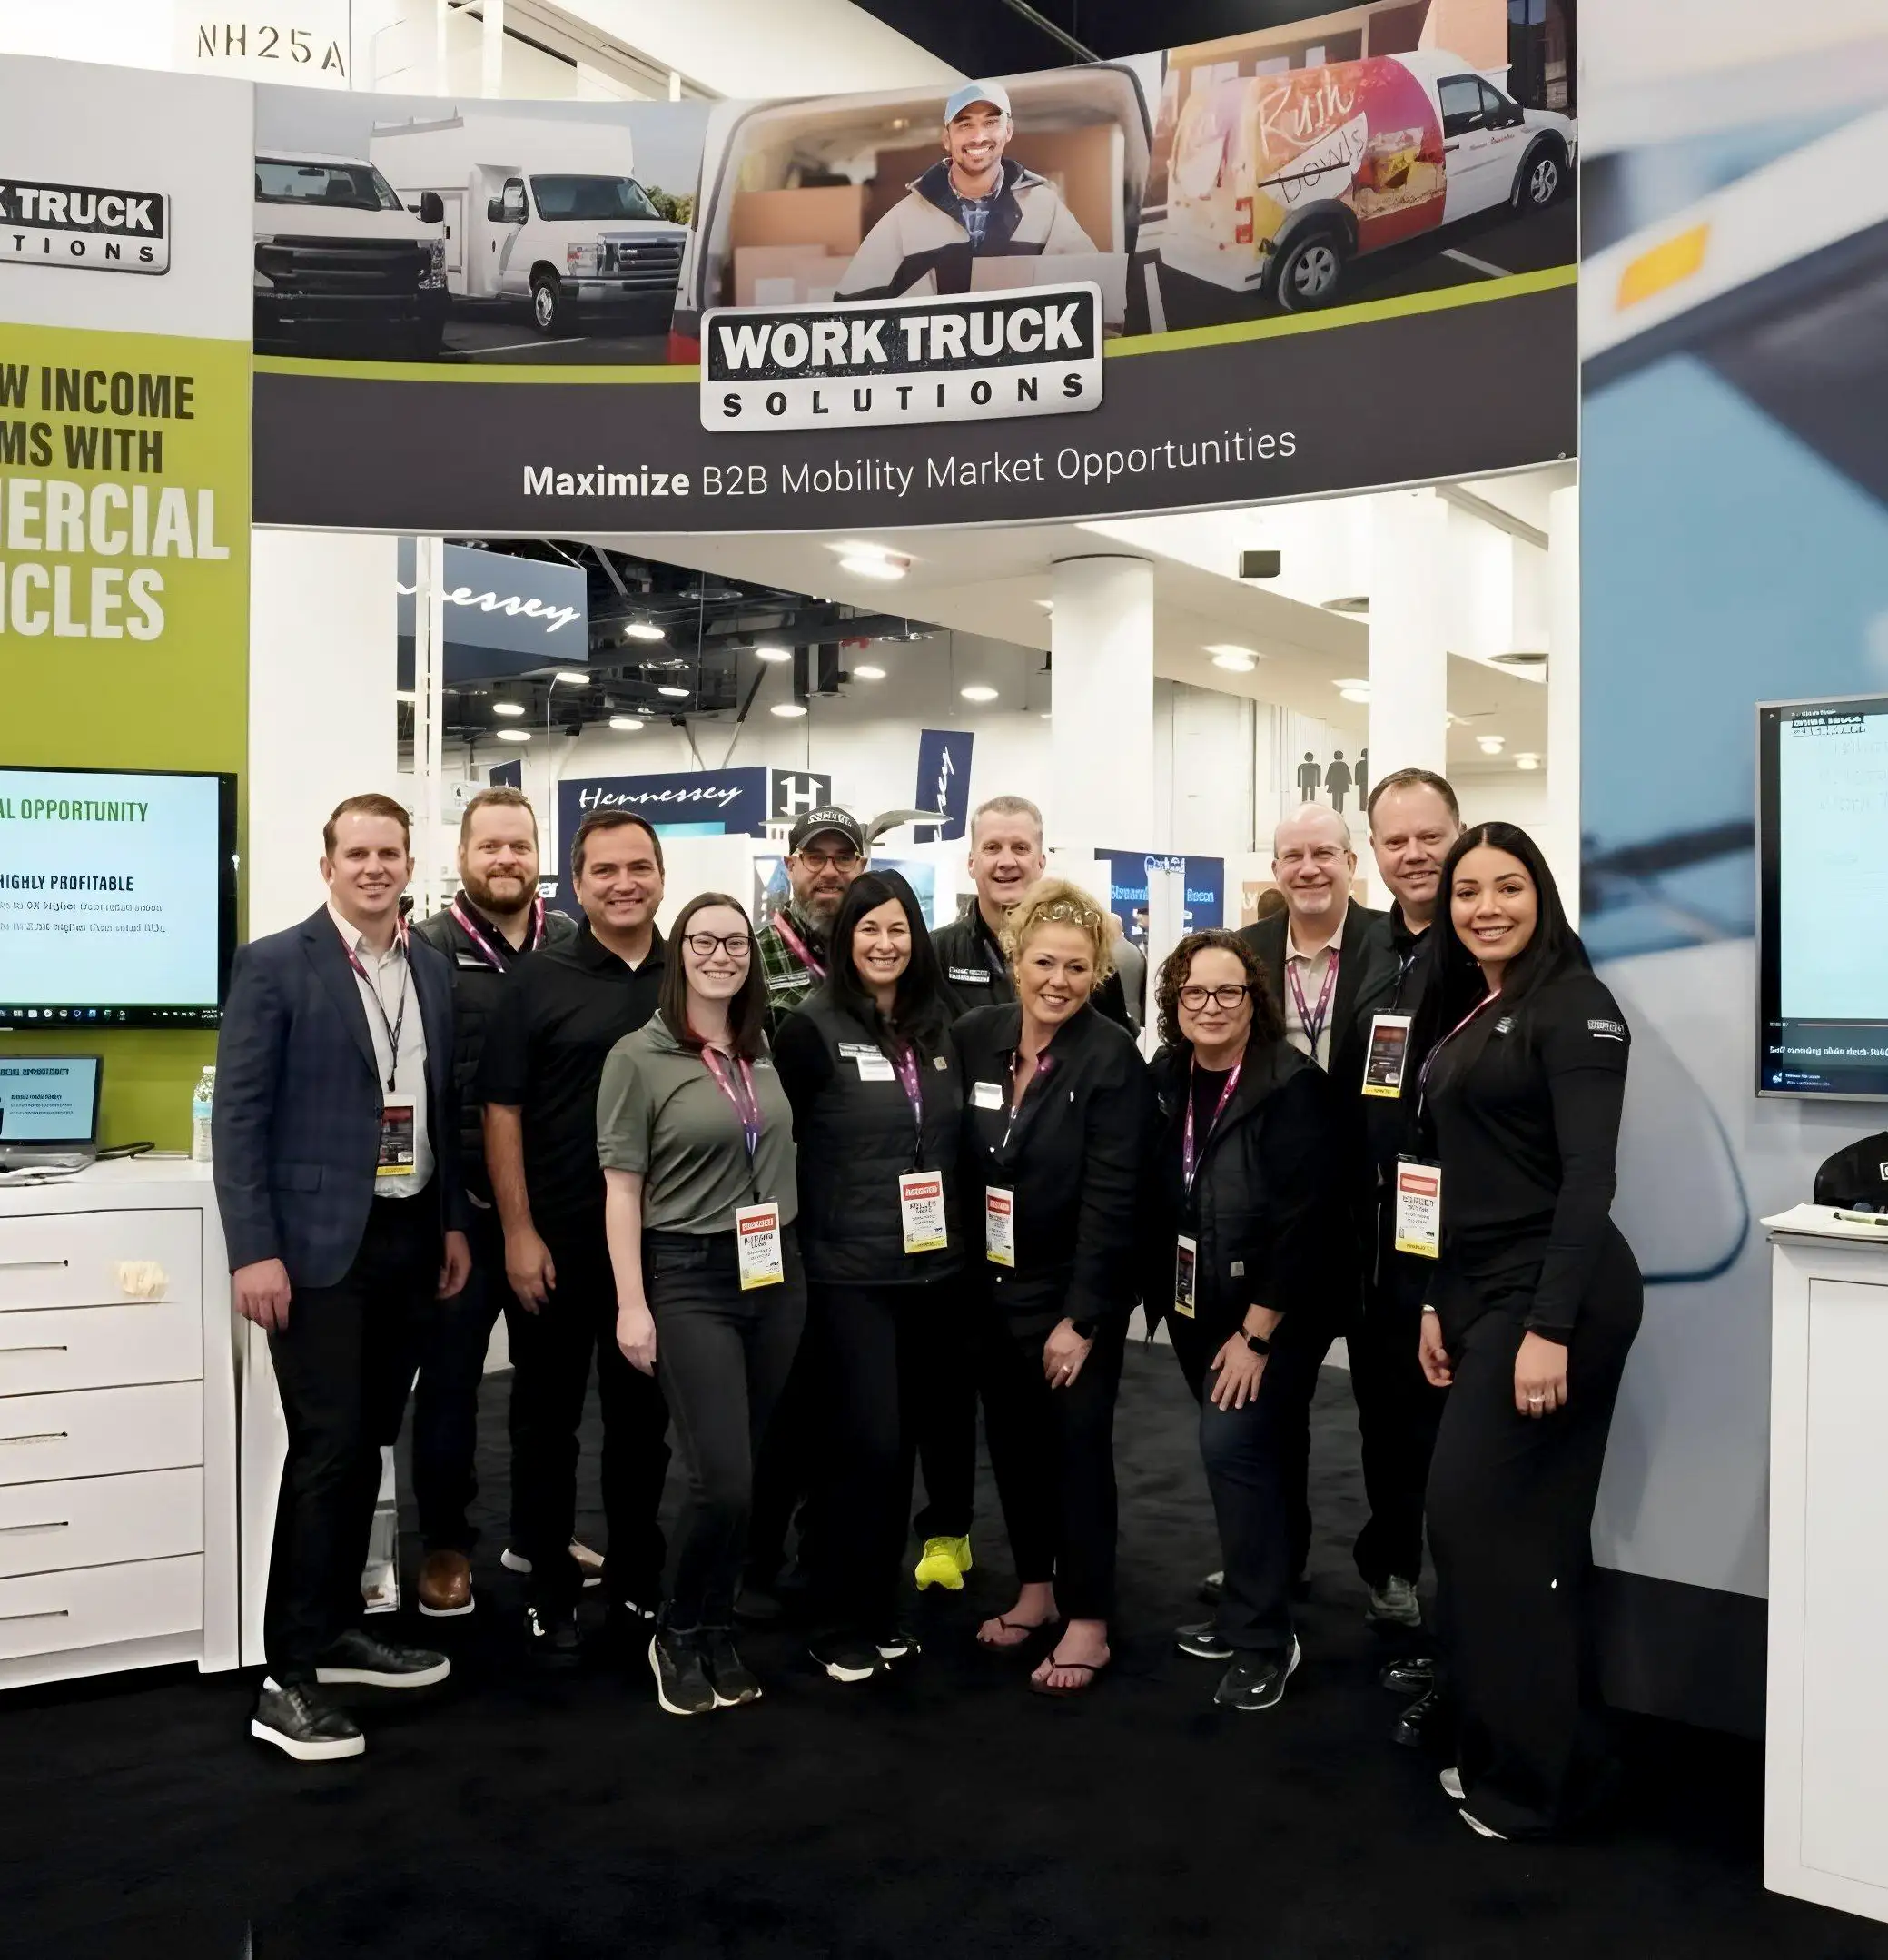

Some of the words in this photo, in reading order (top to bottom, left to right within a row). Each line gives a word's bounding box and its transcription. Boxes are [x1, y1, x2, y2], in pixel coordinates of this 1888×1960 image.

[1258, 69, 1355, 161] Rush
[15, 186, 154, 231] TRUCK
[718, 318, 888, 370] WORK
[900, 302, 1083, 361] TRUCK
[41, 366, 194, 419] INCOME
[722, 373, 1083, 418] SOLUTIONS
[64, 424, 163, 473] WITH
[523, 464, 690, 496] Maximize
[703, 465, 768, 496] B2B
[782, 458, 914, 498] Mobility
[927, 451, 1044, 488] Market
[1057, 427, 1298, 485] Opportunities
[0, 478, 230, 559] ERCIAL
[21, 799, 149, 822] OPPORTUNITY
[578, 785, 744, 809] Hennessey
[50, 875, 133, 892] PROFITABLE
